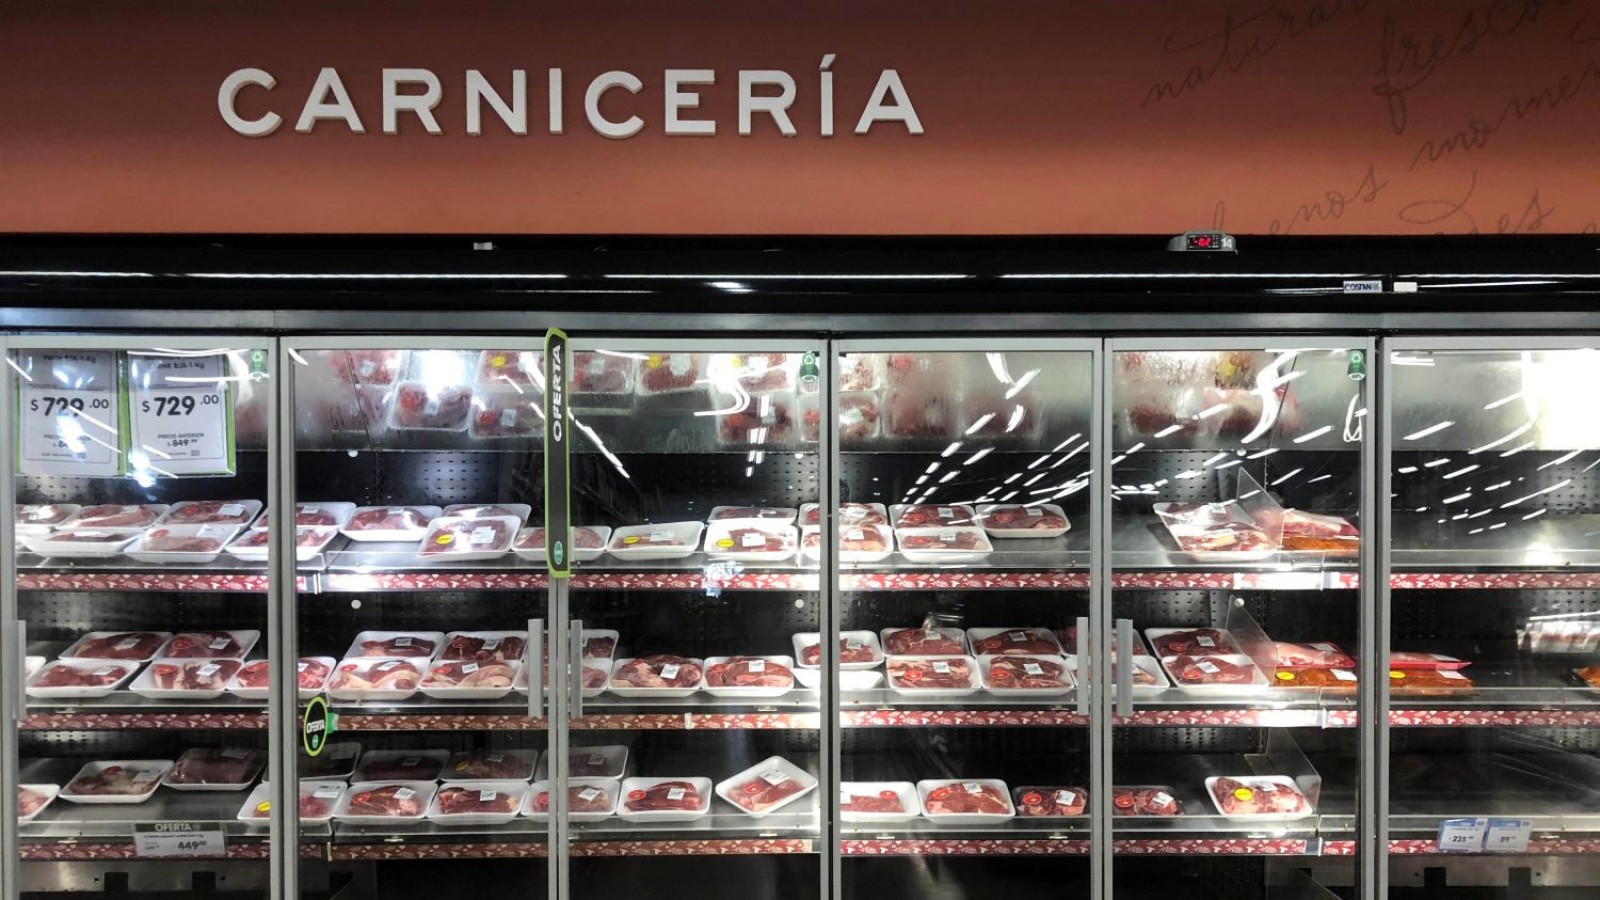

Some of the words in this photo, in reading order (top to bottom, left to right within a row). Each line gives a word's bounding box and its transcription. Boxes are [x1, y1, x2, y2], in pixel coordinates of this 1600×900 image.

[218, 53, 925, 139] CARNICERÍA
[1221, 238, 1233, 249] 14
[552, 344, 563, 443] OFERTA
[30, 398, 39, 412] $
[43, 396, 84, 417] 729
[142, 400, 151, 413] $
[153, 395, 196, 417] 729
[172, 439, 189, 447] 849
[155, 823, 192, 832] OFERTA
